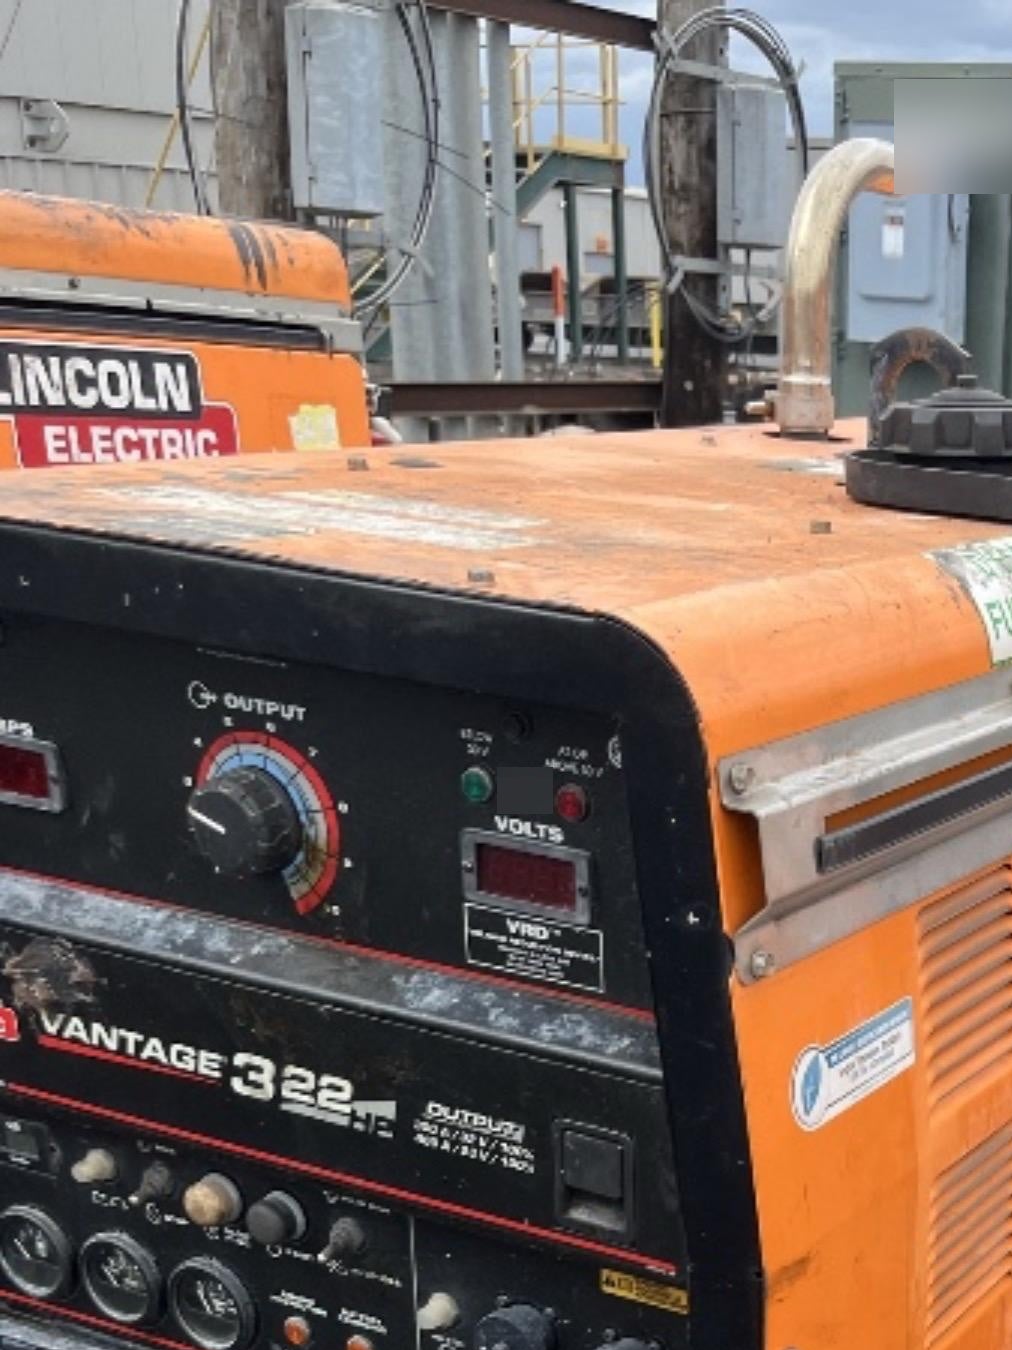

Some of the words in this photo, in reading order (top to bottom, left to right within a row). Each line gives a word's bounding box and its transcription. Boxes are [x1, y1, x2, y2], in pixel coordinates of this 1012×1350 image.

[43, 424, 220, 464] ELECTRIC
[223, 692, 307, 722] OUTPUT
[493, 814, 565, 844] VOLTS
[506, 917, 549, 941] VRD
[38, 1012, 223, 1078] VANTAGE
[229, 1052, 354, 1114] 322
